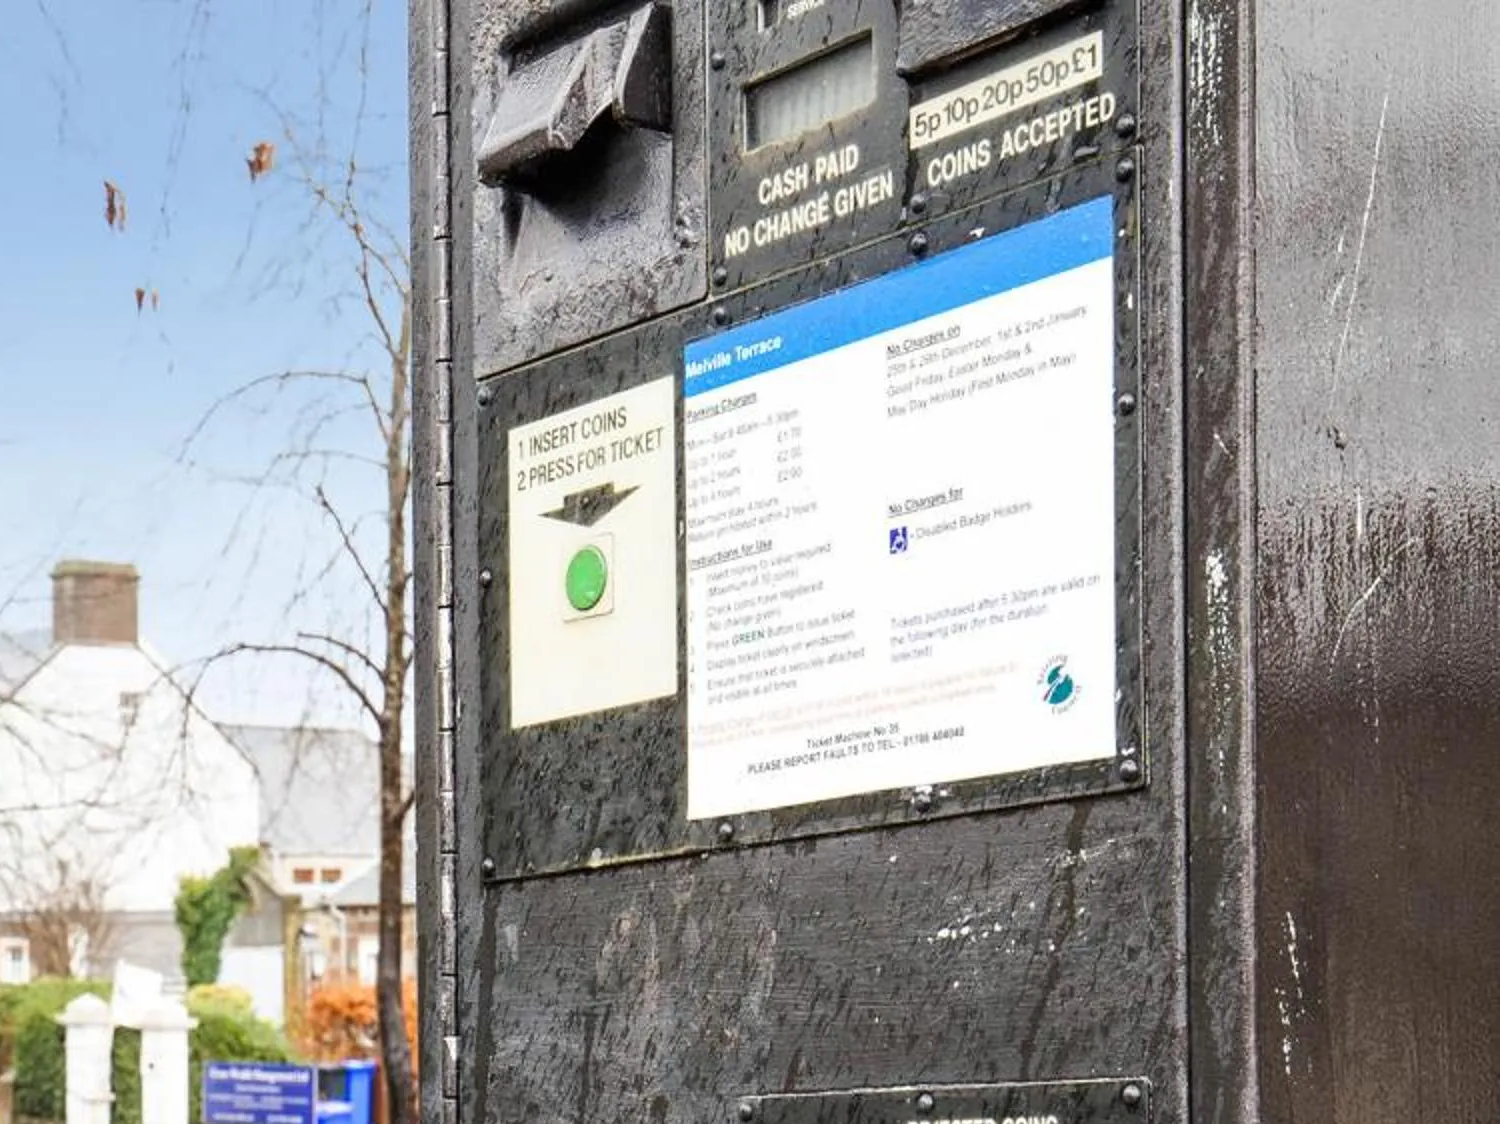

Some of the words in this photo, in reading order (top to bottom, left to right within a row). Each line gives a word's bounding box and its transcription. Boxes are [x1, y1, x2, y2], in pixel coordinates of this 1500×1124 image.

[912, 110, 942, 140] 5p
[943, 97, 979, 129] 10p
[982, 80, 1023, 114] 20p
[1026, 62, 1069, 95] 50p
[1072, 46, 1097, 75] £1
[927, 143, 991, 187] COINS
[999, 92, 1116, 157] ACCEPTED
[758, 166, 808, 205] CASH
[815, 144, 859, 182] PAID
[724, 228, 749, 258] NO
[753, 196, 829, 246] CHANGE
[834, 172, 894, 218] GIVEN
[686, 351, 730, 379] Melville
[735, 335, 780, 361] Terrace
[529, 421, 576, 456] INSERT
[581, 406, 627, 439] COINS
[517, 471, 527, 491] 2
[529, 454, 575, 488] PRESS
[578, 445, 606, 473] FOR
[611, 427, 665, 463] TICKET
[732, 628, 764, 646] GREEN
[747, 758, 781, 774] PLEASE
[784, 751, 820, 768] REPORT
[823, 743, 859, 760] FAULTS
[862, 740, 874, 752] TO
[807, 735, 832, 748] Ticket
[834, 730, 870, 744] Machine
